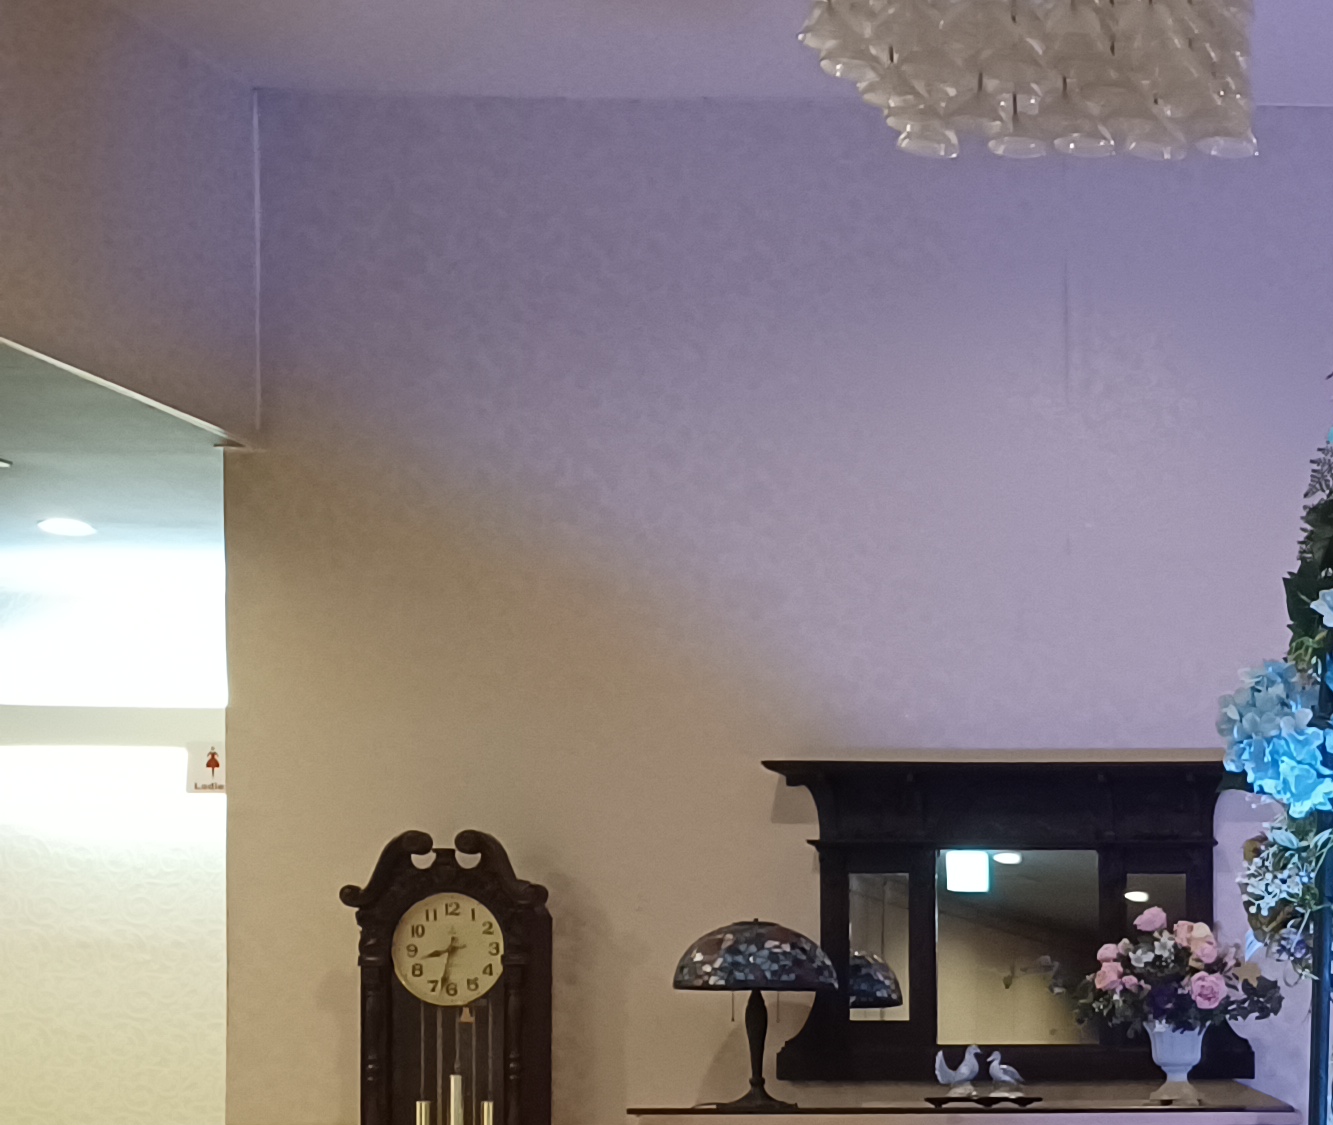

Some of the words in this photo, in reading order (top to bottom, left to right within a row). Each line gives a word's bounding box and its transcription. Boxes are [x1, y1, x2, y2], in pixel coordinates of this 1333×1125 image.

[194, 782, 224, 790] Ladie
[425, 908, 438, 922] 11
[444, 901, 460, 916] 12
[471, 908, 476, 921] 1
[411, 924, 425, 938] 10
[482, 921, 494, 935] 2
[406, 944, 418, 958] 9
[488, 941, 500, 956] 3
[411, 963, 423, 977] 8
[482, 963, 493, 976] 4
[427, 979, 439, 992] 7
[446, 982, 458, 997] 6
[467, 977, 479, 991] 5
